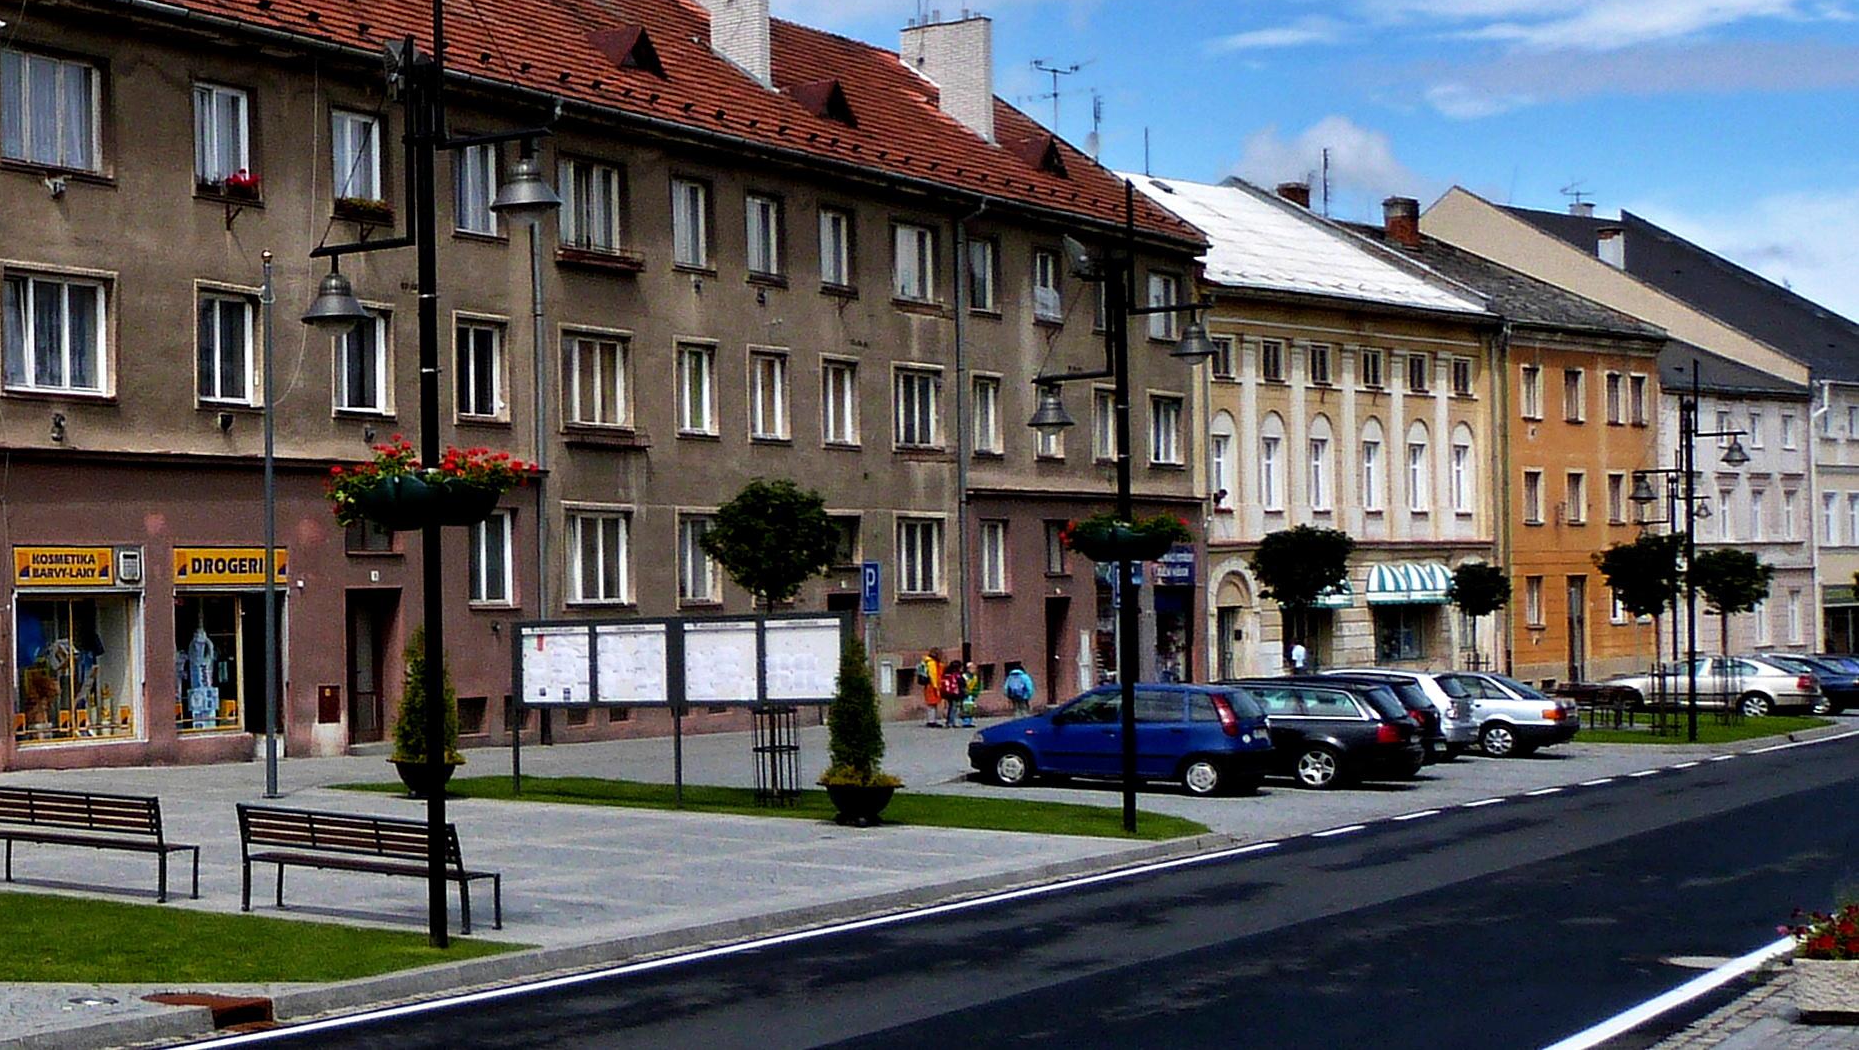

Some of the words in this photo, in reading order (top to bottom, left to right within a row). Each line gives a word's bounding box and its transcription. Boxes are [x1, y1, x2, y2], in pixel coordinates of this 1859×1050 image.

[32, 554, 96, 565] KOSMETIKA
[191, 557, 263, 574] DROGERI
[866, 568, 875, 597] P
